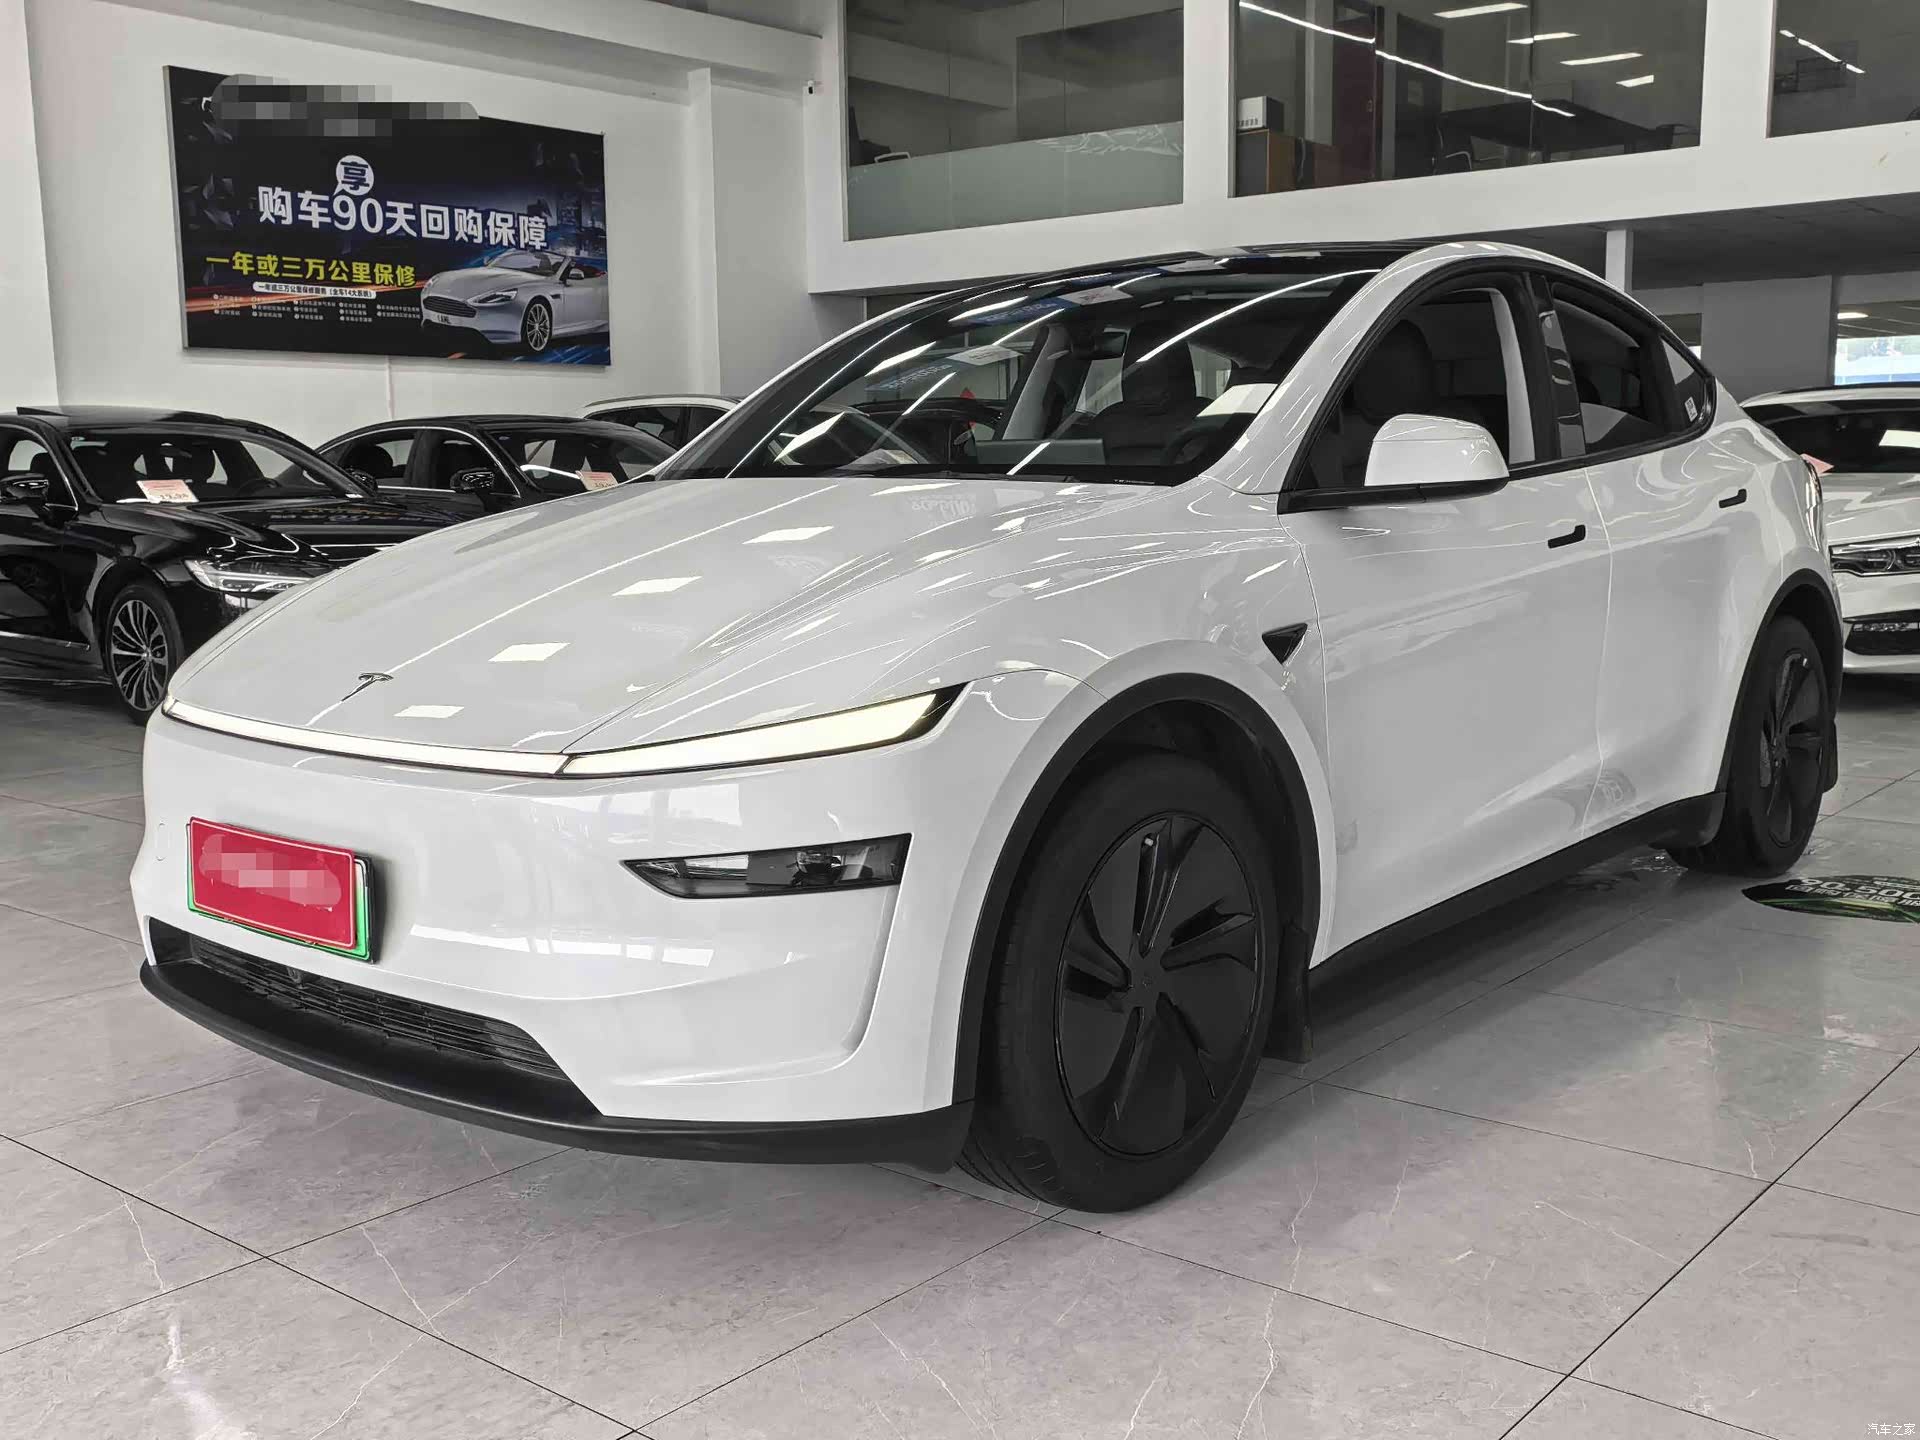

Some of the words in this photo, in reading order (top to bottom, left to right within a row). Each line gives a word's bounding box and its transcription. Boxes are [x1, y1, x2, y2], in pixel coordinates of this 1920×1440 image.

[340, 161, 370, 191] 享
[258, 186, 547, 249] 购车90天回购保障
[206, 251, 415, 287] 一年或三万公里保修
